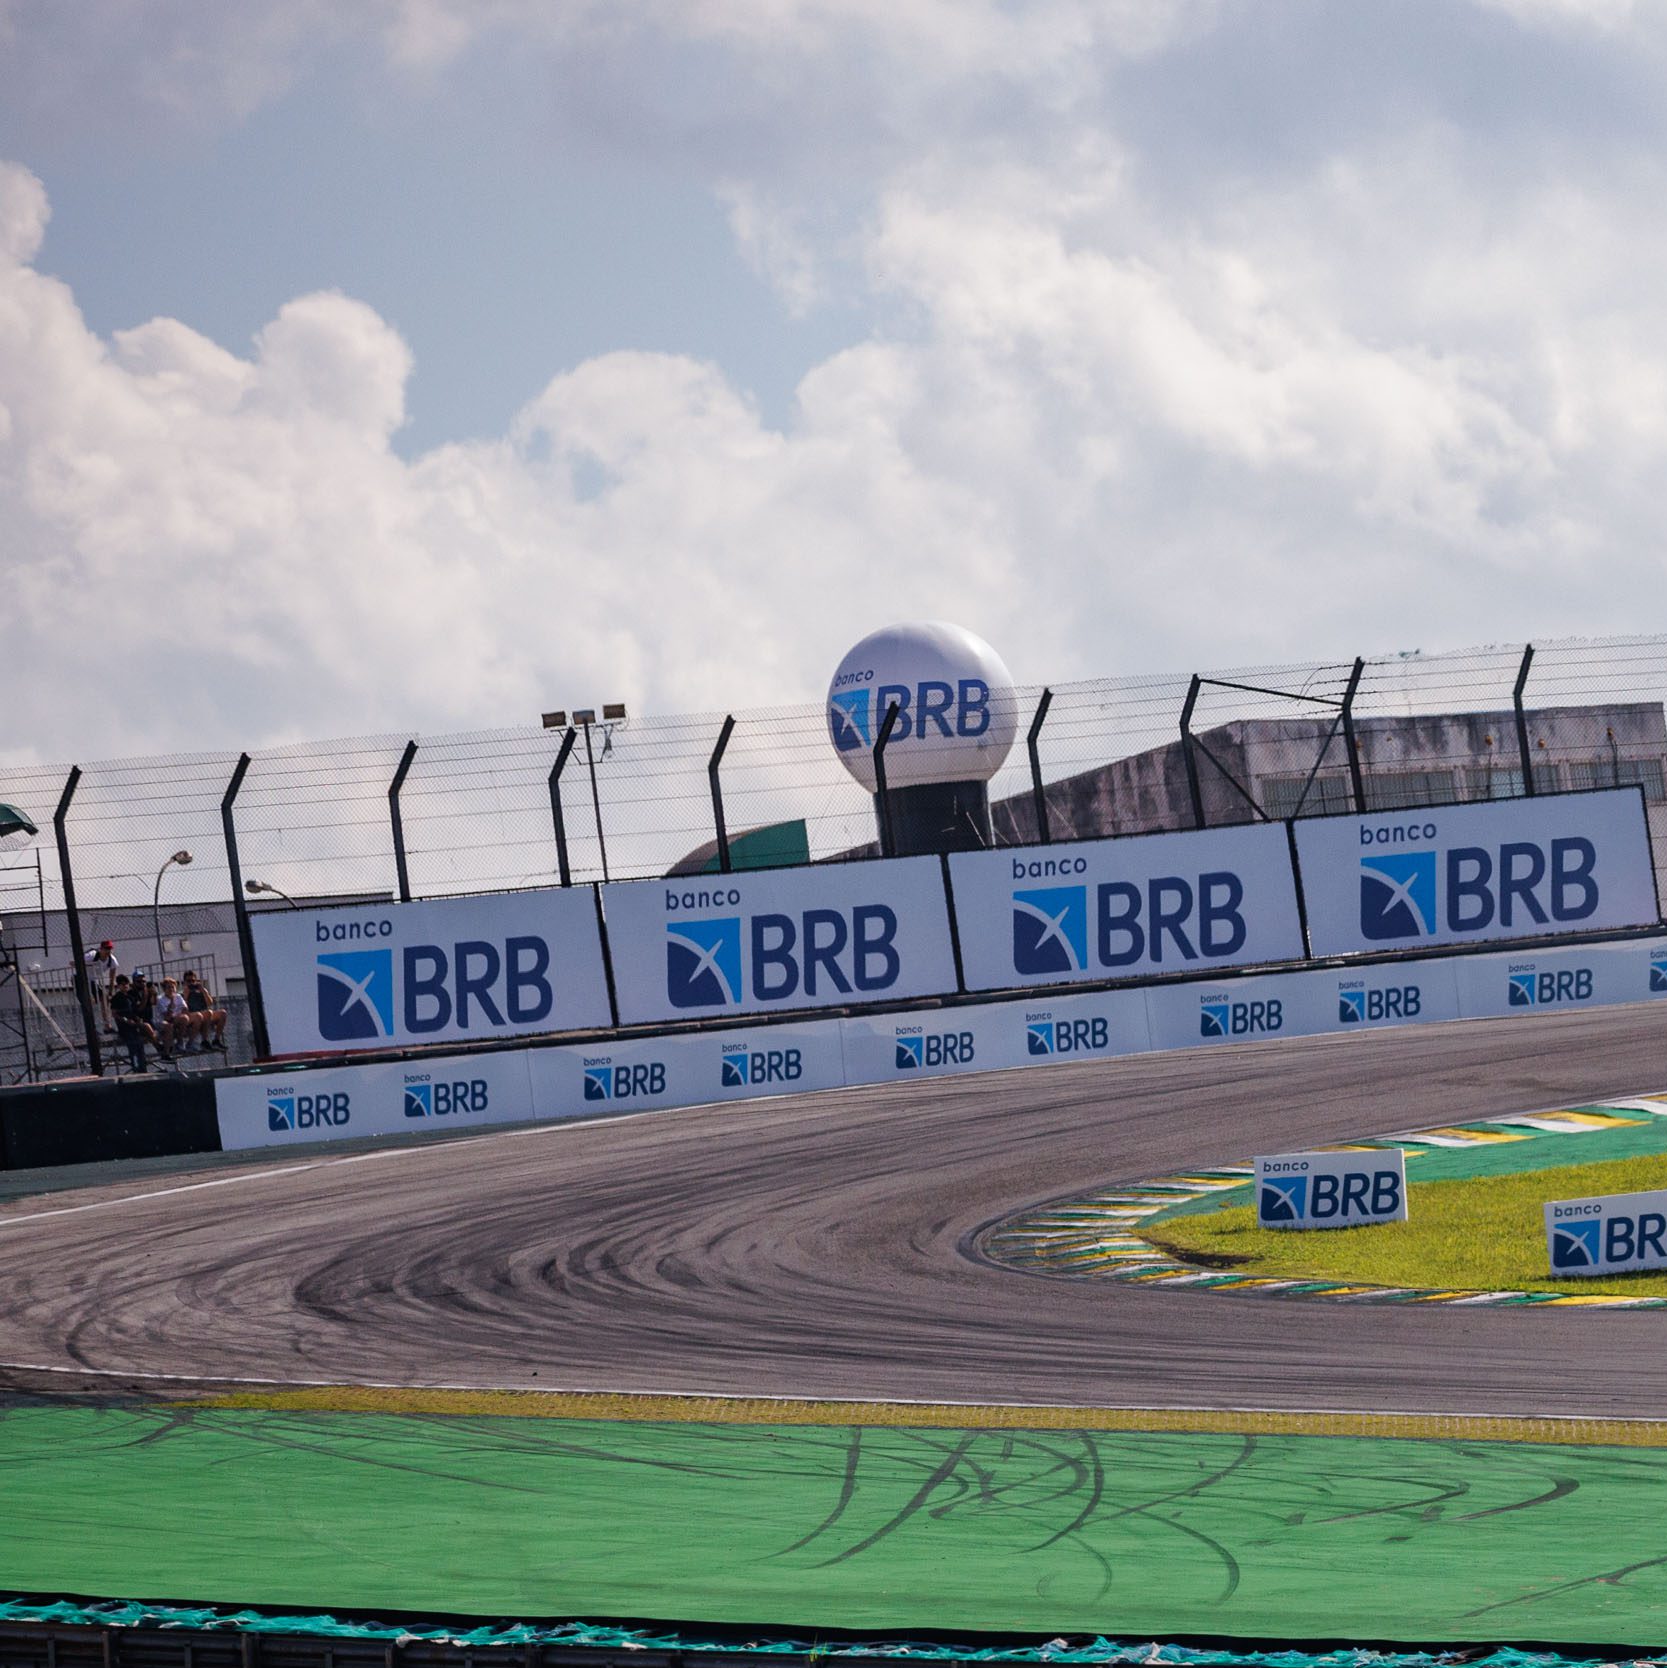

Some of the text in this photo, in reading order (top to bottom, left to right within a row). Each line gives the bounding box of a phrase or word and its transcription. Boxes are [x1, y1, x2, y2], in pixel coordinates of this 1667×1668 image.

[835, 669, 875, 687] banco
[876, 678, 990, 744] BRB
[1360, 822, 1437, 846] banco
[1012, 856, 1087, 880] banco
[1447, 836, 1599, 932] BRB
[665, 887, 741, 911] banco
[316, 918, 393, 942] banco
[1097, 871, 1247, 967] BRB
[751, 904, 900, 1001] BRB
[1508, 963, 1535, 973] banco
[404, 935, 554, 1034] BRB
[1338, 981, 1364, 990] banco
[1538, 968, 1593, 1003] BRB
[1200, 994, 1229, 1004] banco
[1367, 986, 1421, 1020] BRB
[1026, 1012, 1052, 1022] banco
[1231, 999, 1283, 1034] BRB
[896, 1025, 922, 1035] banco
[1055, 1017, 1109, 1052] BRB
[722, 1042, 748, 1052] banco
[925, 1031, 975, 1067] BRB
[583, 1056, 612, 1067] banco
[750, 1048, 803, 1083] BRB
[404, 1073, 431, 1083] banco
[614, 1062, 666, 1099] BRB
[267, 1086, 294, 1097] banco
[434, 1079, 488, 1115] BRB
[297, 1092, 350, 1129] BRB
[1263, 1159, 1309, 1174] banco
[1310, 1170, 1400, 1219] BRB
[1554, 1203, 1602, 1218] banco
